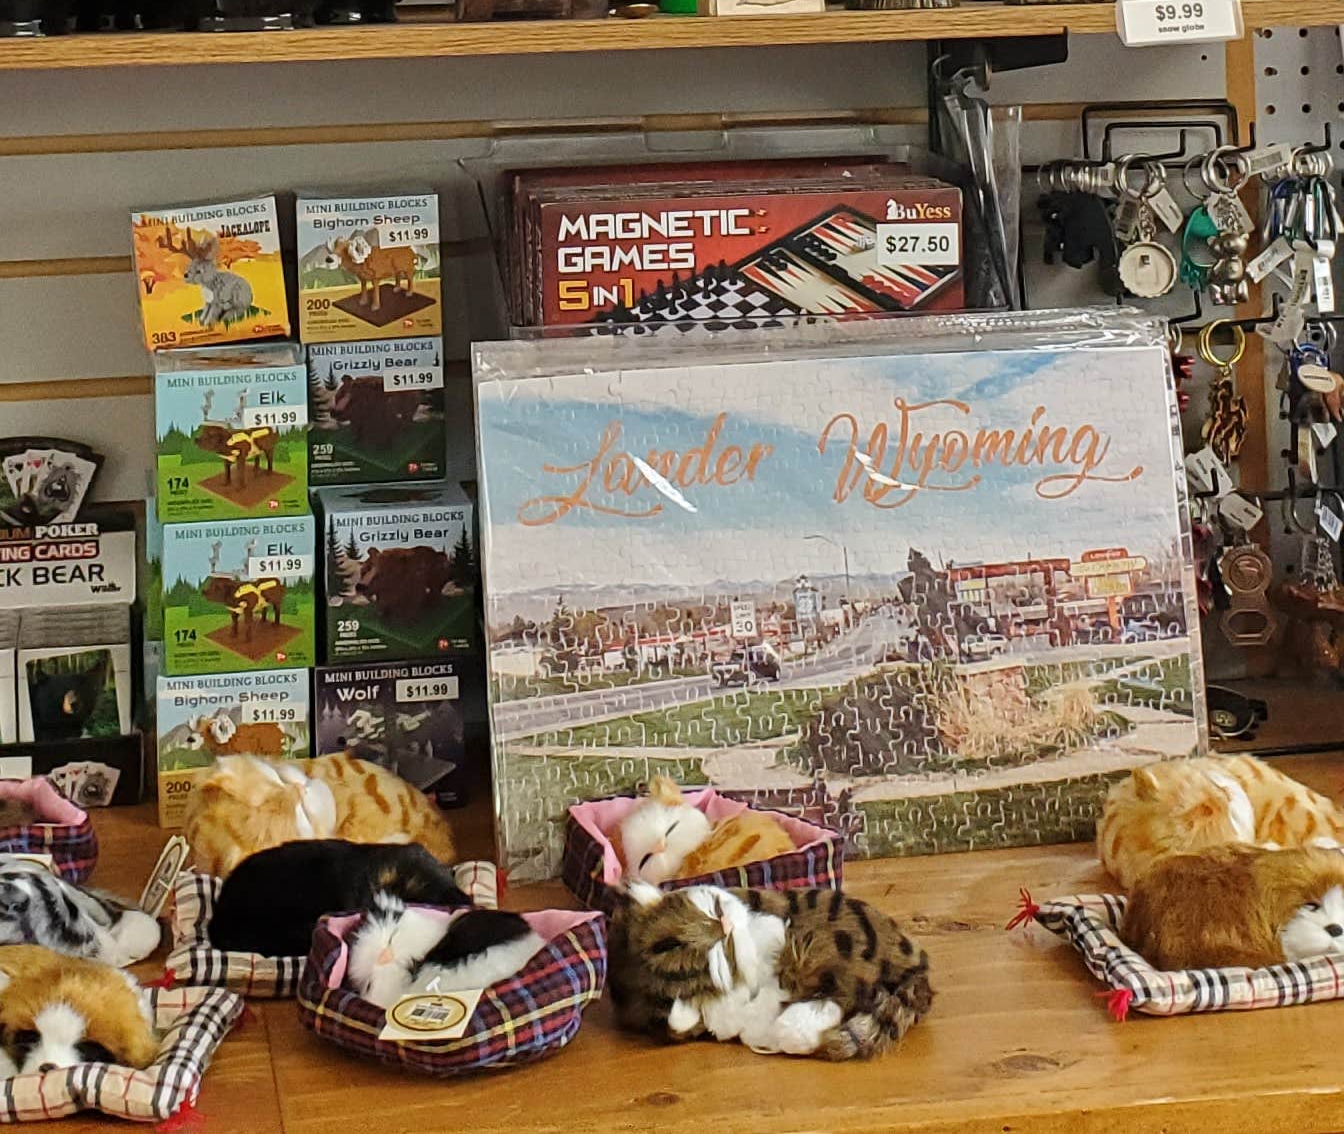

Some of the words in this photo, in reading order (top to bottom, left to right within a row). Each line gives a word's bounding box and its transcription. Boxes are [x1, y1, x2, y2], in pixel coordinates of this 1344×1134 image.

[1155, 2, 1203, 22] $9.99
[219, 219, 271, 238] JACKALOPE
[312, 215, 369, 229] Bighorn
[373, 213, 421, 226] Sheep
[558, 207, 752, 241] MAGNETIC
[388, 227, 429, 243] $11.99
[885, 234, 951, 255] $27.50
[558, 242, 695, 273] GAMES
[558, 280, 590, 311] 5
[593, 284, 618, 307] IN
[619, 278, 635, 308] 1
[306, 298, 331, 311] 200
[333, 357, 381, 371] Grizzly
[385, 356, 418, 368] Bear
[167, 377, 195, 388] MINI
[197, 374, 253, 387] BUILDING
[255, 371, 297, 383] BLOCKS
[393, 372, 433, 386] $11.99
[259, 391, 287, 405] Elk
[254, 411, 297, 426] $11.99
[518, 411, 775, 527] Lander
[817, 396, 1144, 510] Wyoming
[166, 477, 189, 490] 174
[35, 522, 99, 540] POKER
[174, 529, 203, 540] MINI
[205, 526, 260, 539] BUILDING
[263, 523, 305, 535] BLOCKS
[359, 529, 410, 544] Grizzly
[413, 527, 449, 540] Bear
[35, 541, 97, 560] CARDS
[267, 542, 294, 556] Elk
[259, 558, 302, 573] $11.99
[32, 563, 105, 586] BEAR
[336, 685, 380, 702] Wolf
[406, 683, 449, 698] $11.99
[174, 694, 234, 709] Bighorn
[238, 690, 289, 705] Sheep
[252, 708, 295, 722] $11.99
